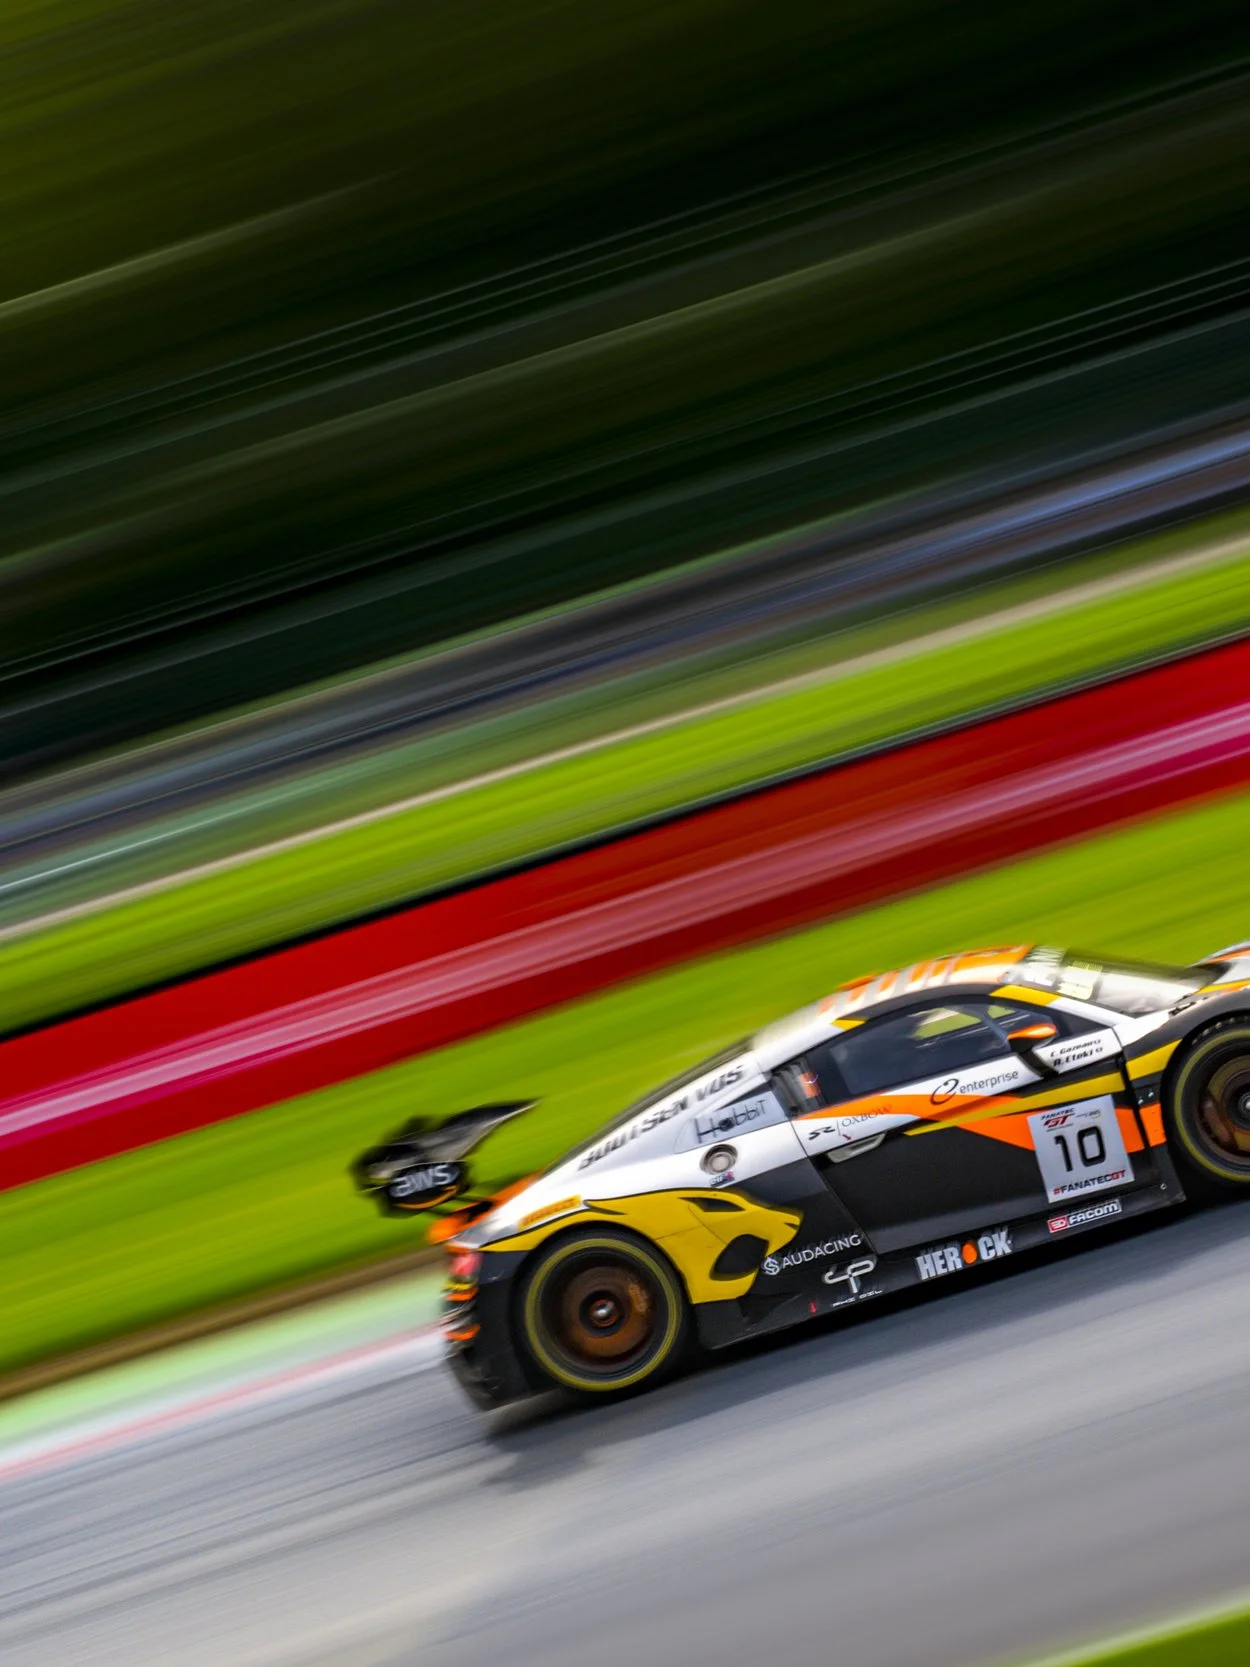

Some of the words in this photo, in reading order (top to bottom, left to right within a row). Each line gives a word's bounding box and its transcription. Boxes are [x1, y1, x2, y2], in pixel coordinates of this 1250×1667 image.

[960, 1069, 1019, 1094] enterprise
[1054, 1125, 1107, 1173] 10
[1053, 1169, 1127, 1196] #FANATECGT
[782, 1234, 862, 1269] AUDACING
